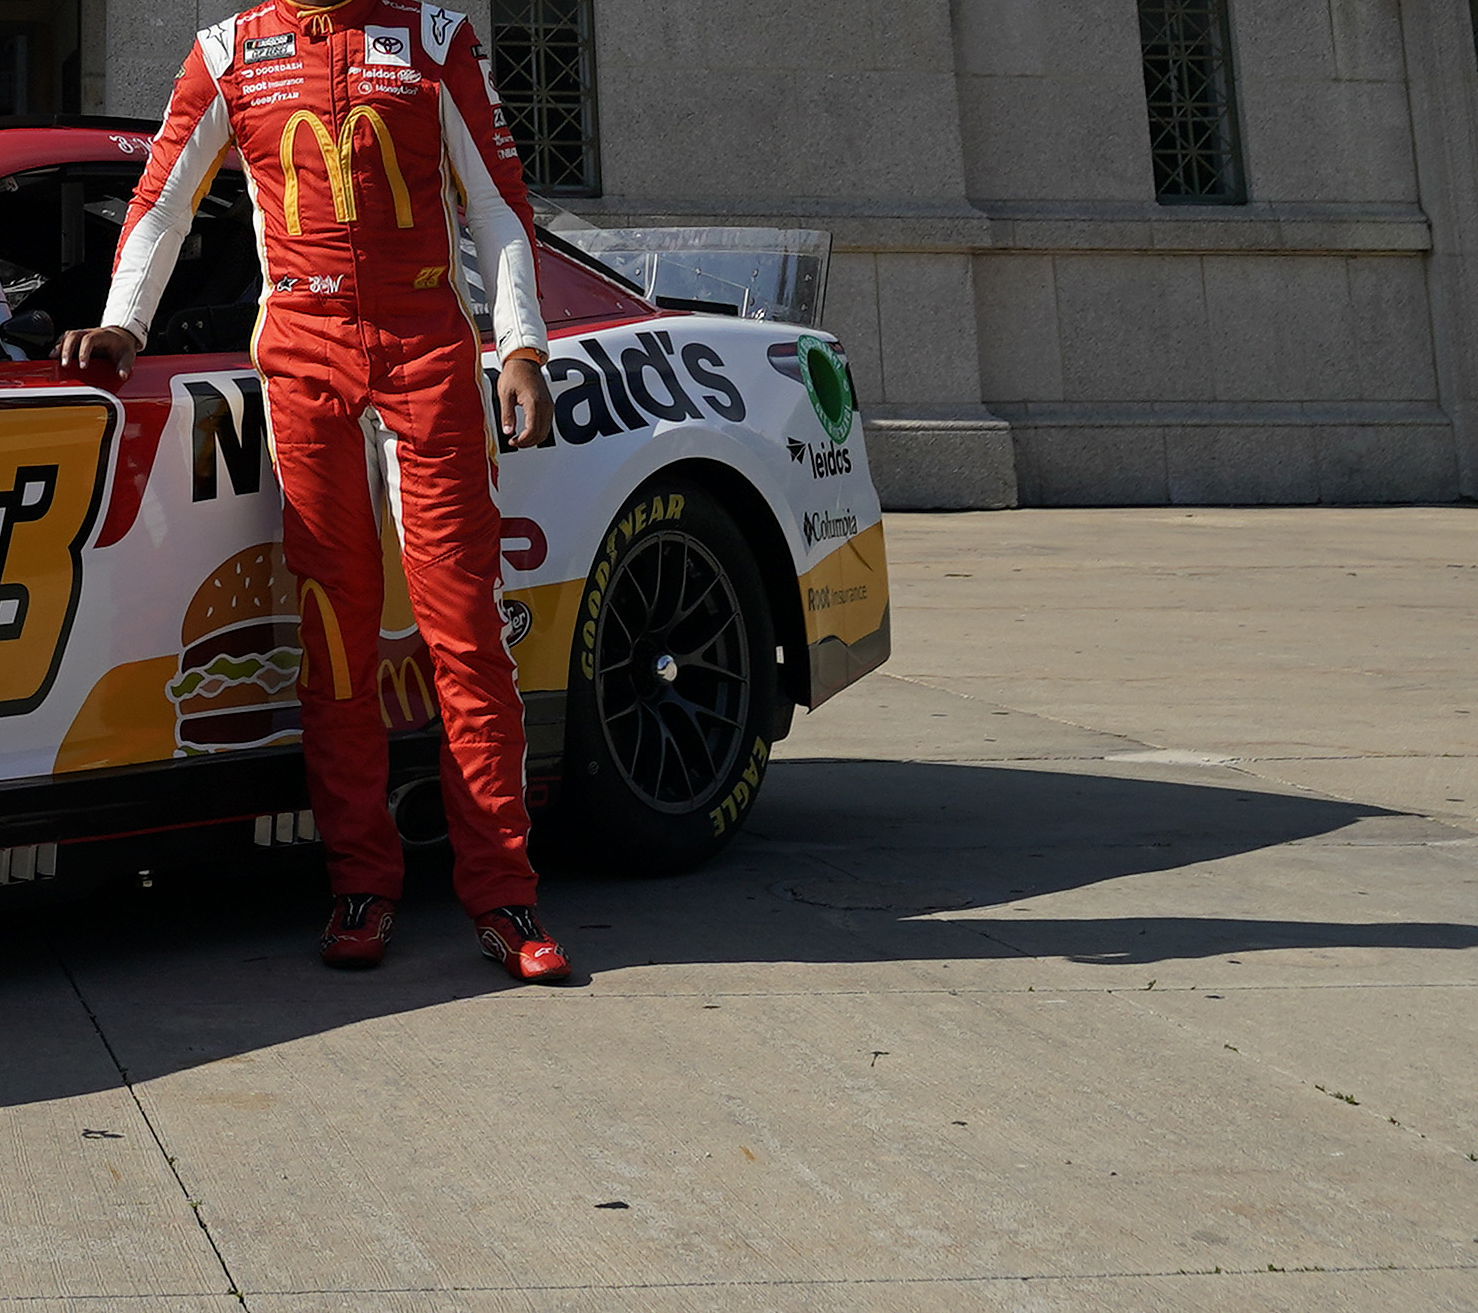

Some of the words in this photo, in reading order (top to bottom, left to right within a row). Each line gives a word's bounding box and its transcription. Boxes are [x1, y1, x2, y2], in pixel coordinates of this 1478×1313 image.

[242, 81, 267, 95] Root
[808, 440, 852, 479] leidos
[708, 735, 769, 838] EAGLE
